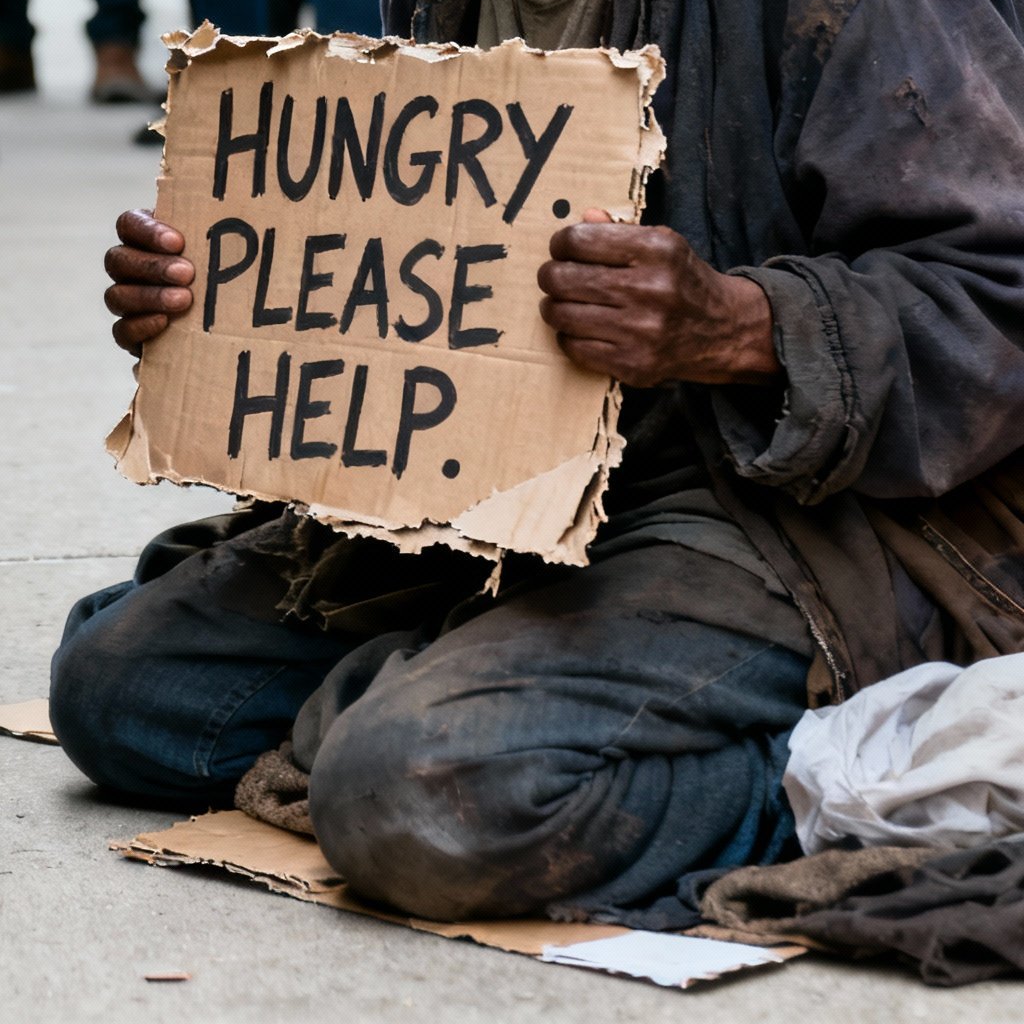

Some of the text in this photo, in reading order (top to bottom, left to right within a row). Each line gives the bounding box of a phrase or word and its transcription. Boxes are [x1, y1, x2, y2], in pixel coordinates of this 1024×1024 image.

[212, 81, 575, 225] HUNGRY.
[203, 218, 508, 350] PLEASE
[228, 351, 461, 480] HELP.
